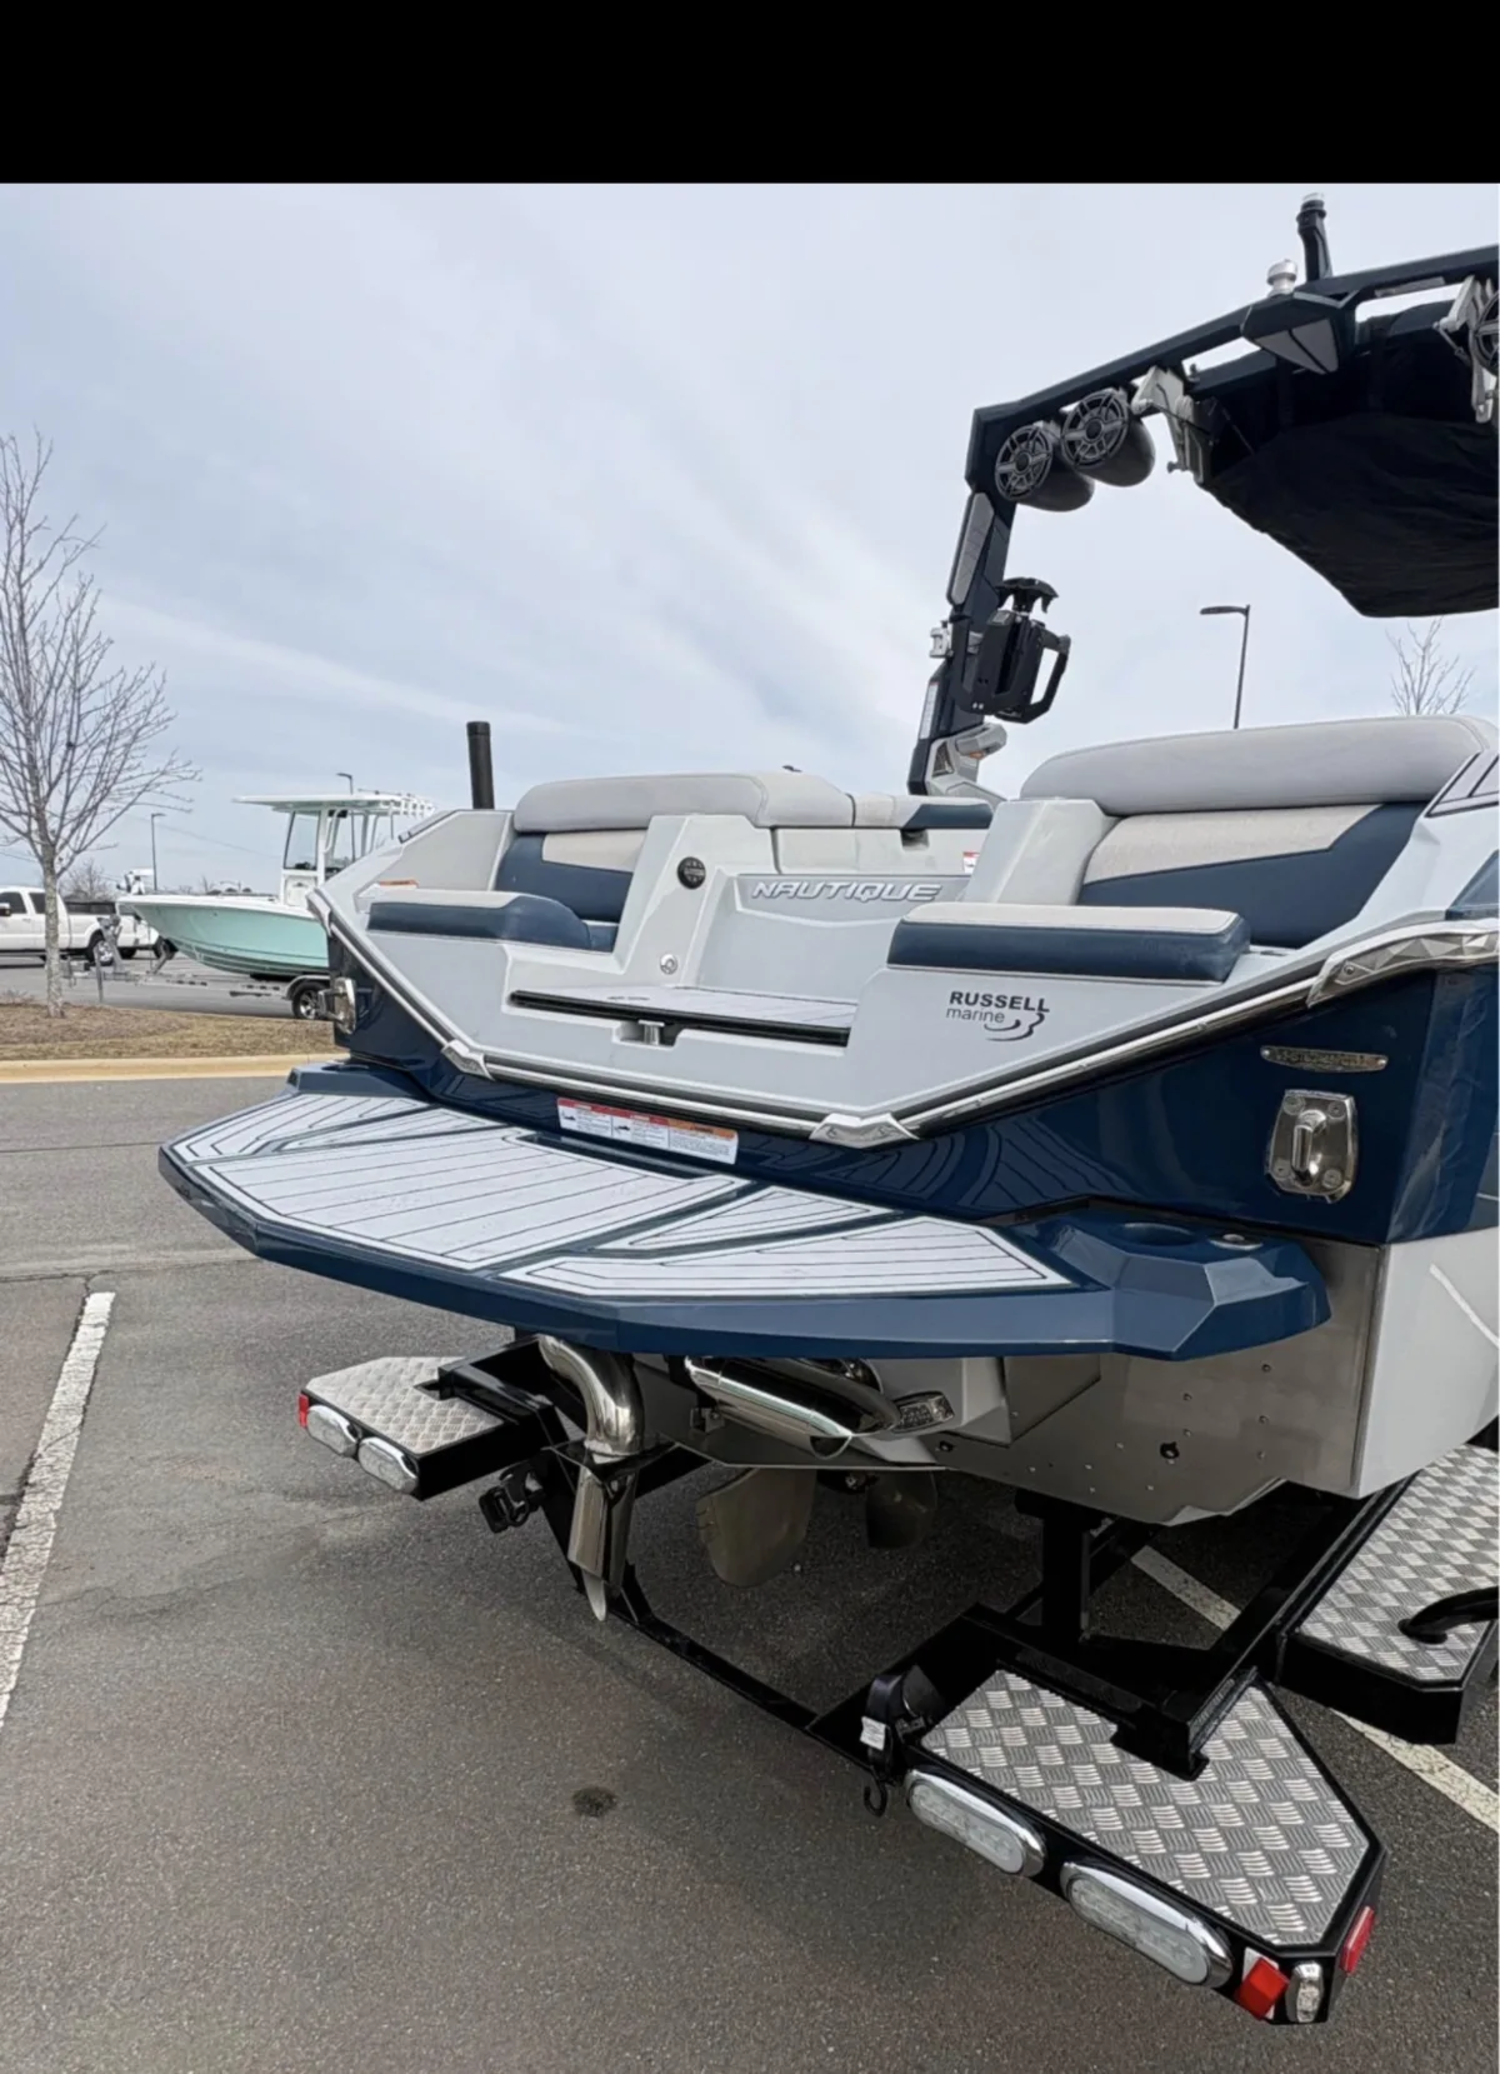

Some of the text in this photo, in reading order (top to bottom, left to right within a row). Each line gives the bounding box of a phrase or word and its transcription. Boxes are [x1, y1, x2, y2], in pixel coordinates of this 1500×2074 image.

[752, 880, 941, 903] NAUTIQUE
[949, 991, 1050, 1013] RUSSELL
[946, 1007, 1005, 1023] marine
